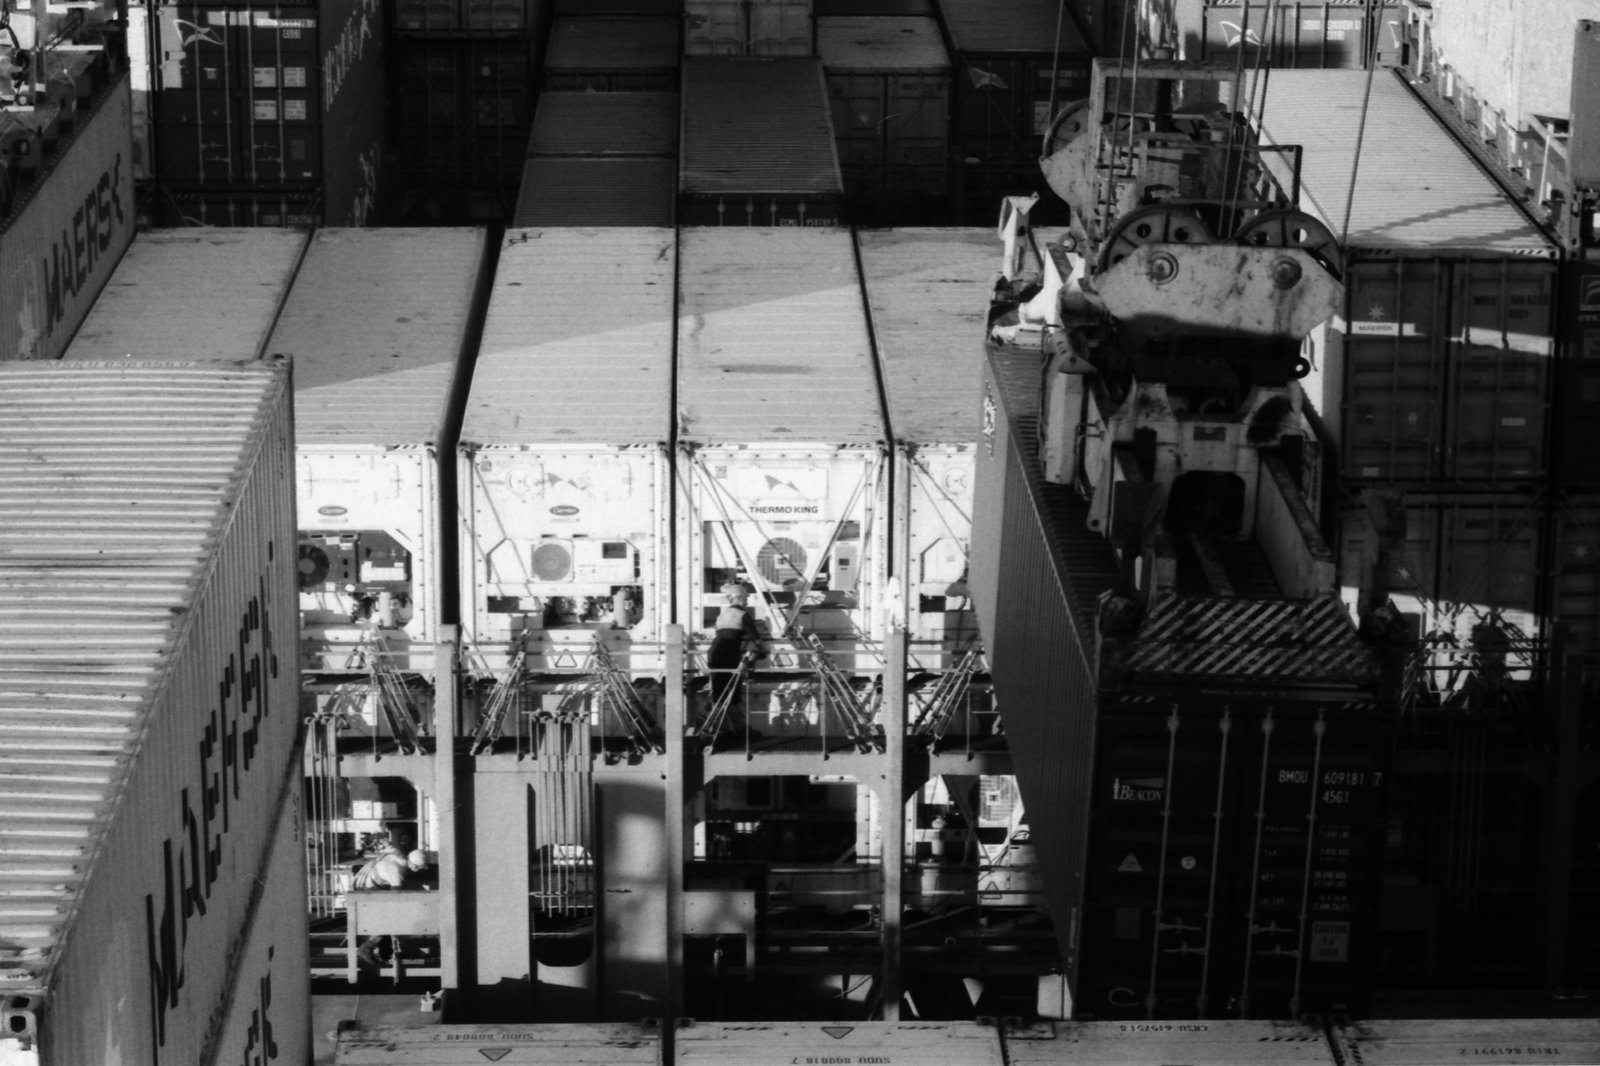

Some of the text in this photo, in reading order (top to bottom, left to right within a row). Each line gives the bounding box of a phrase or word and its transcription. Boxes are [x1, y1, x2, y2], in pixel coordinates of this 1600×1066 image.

[749, 506, 818, 514] THERMO KING
[1278, 770, 1382, 787] BMOU 609181 7
[1322, 790, 1349, 804] 45G1
